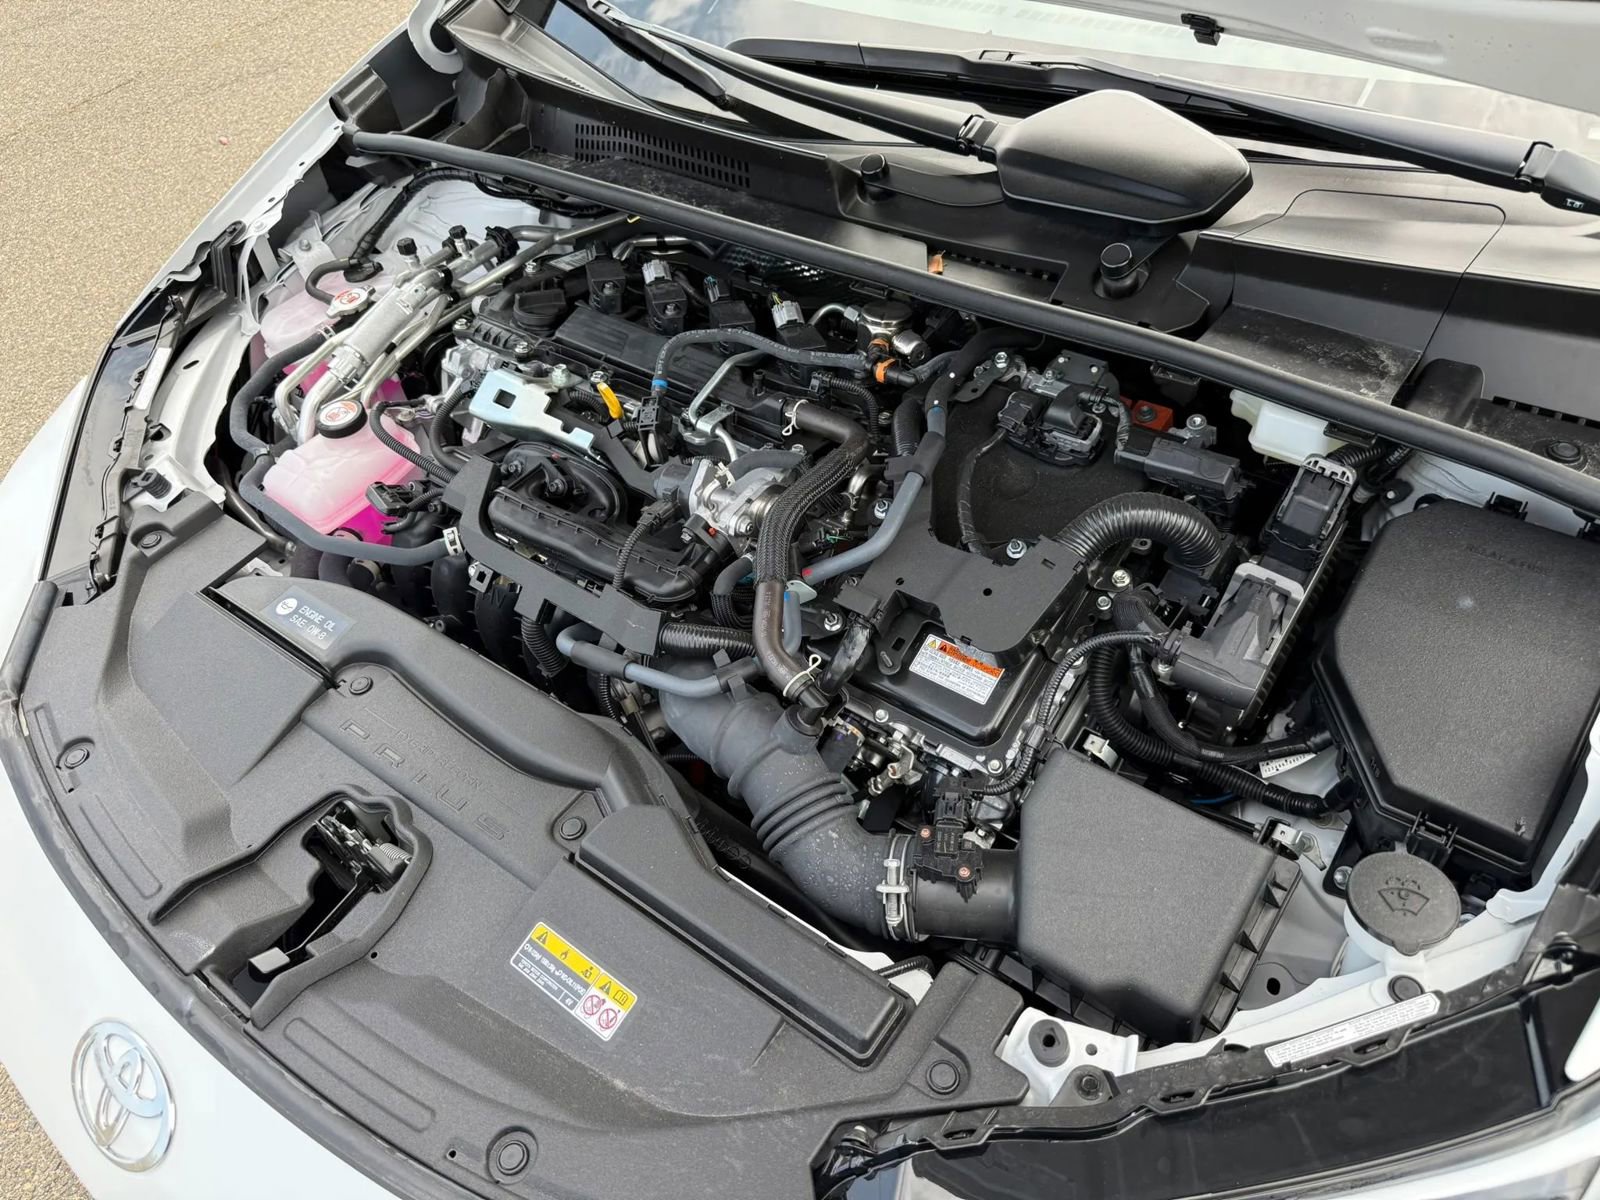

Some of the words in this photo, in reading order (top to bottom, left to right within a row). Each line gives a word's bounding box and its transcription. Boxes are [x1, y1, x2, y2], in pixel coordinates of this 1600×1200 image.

[289, 614, 307, 628] SAE
[299, 605, 325, 624] ENGINE
[324, 620, 336, 632] OIL
[340, 719, 508, 840] PRIUS
